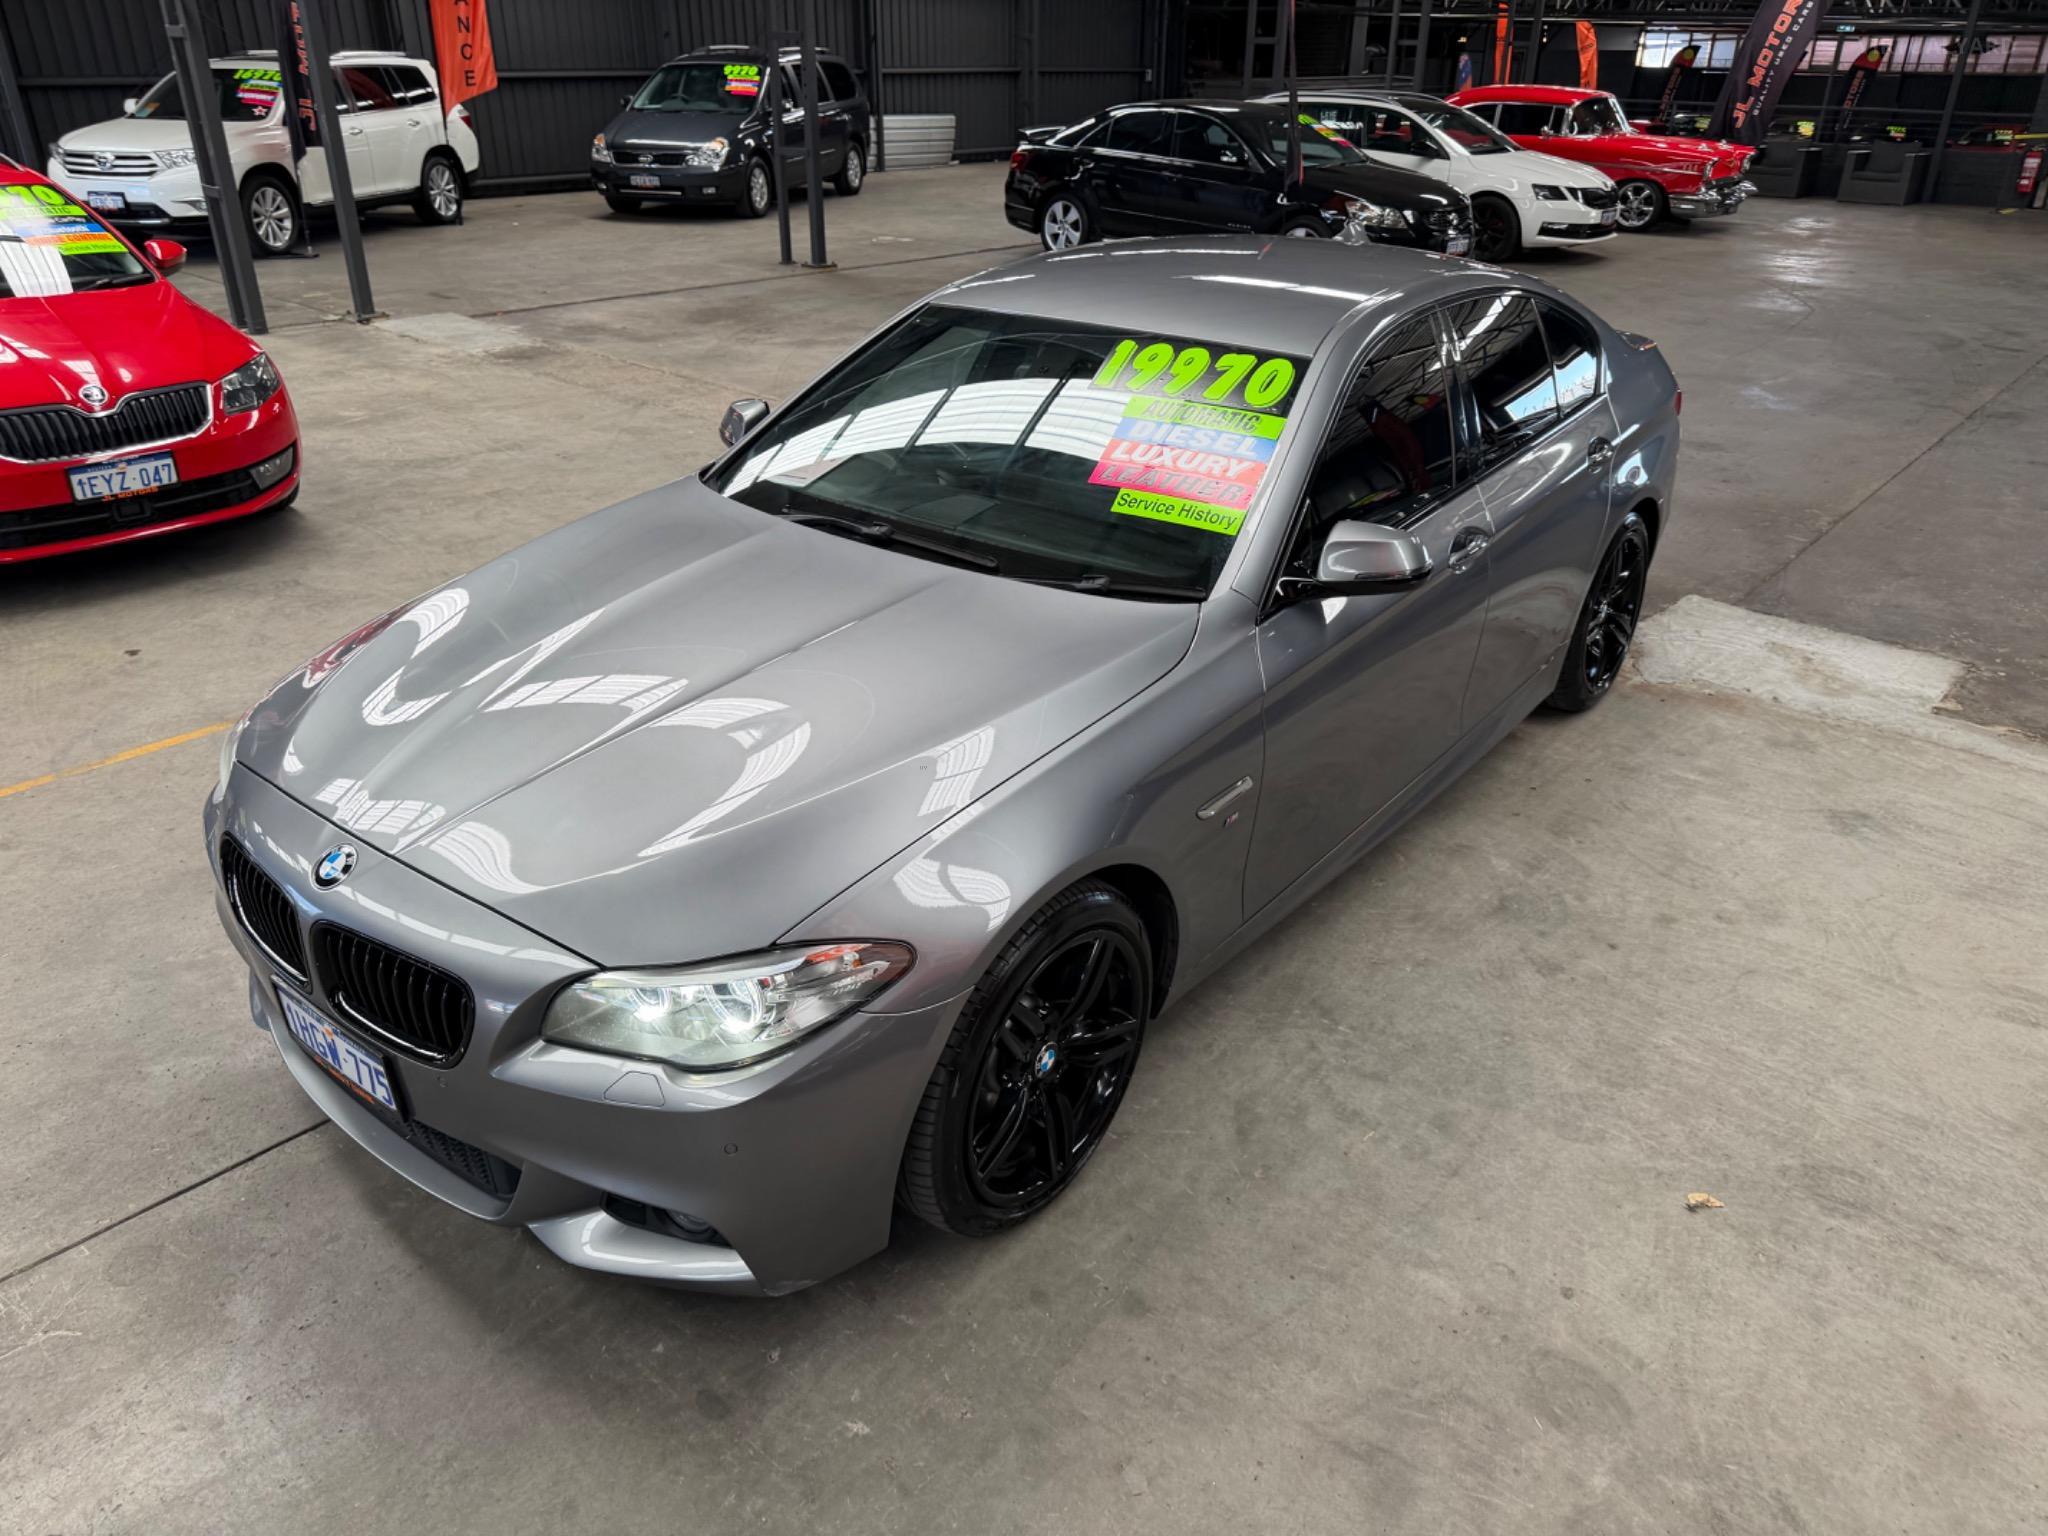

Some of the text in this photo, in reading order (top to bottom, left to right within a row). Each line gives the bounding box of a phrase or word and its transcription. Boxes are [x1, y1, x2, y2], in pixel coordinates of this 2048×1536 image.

[1751, 68, 1775, 116] QUALITY
[1774, 36, 1793, 66] USED
[1093, 338, 1297, 408] 19970
[1141, 399, 1262, 432] AUTOMATIC
[1127, 419, 1259, 456] DIESEL
[1110, 440, 1255, 480] LUXURY
[1098, 464, 1249, 507] LEATHER
[1116, 492, 1238, 531] Service History
